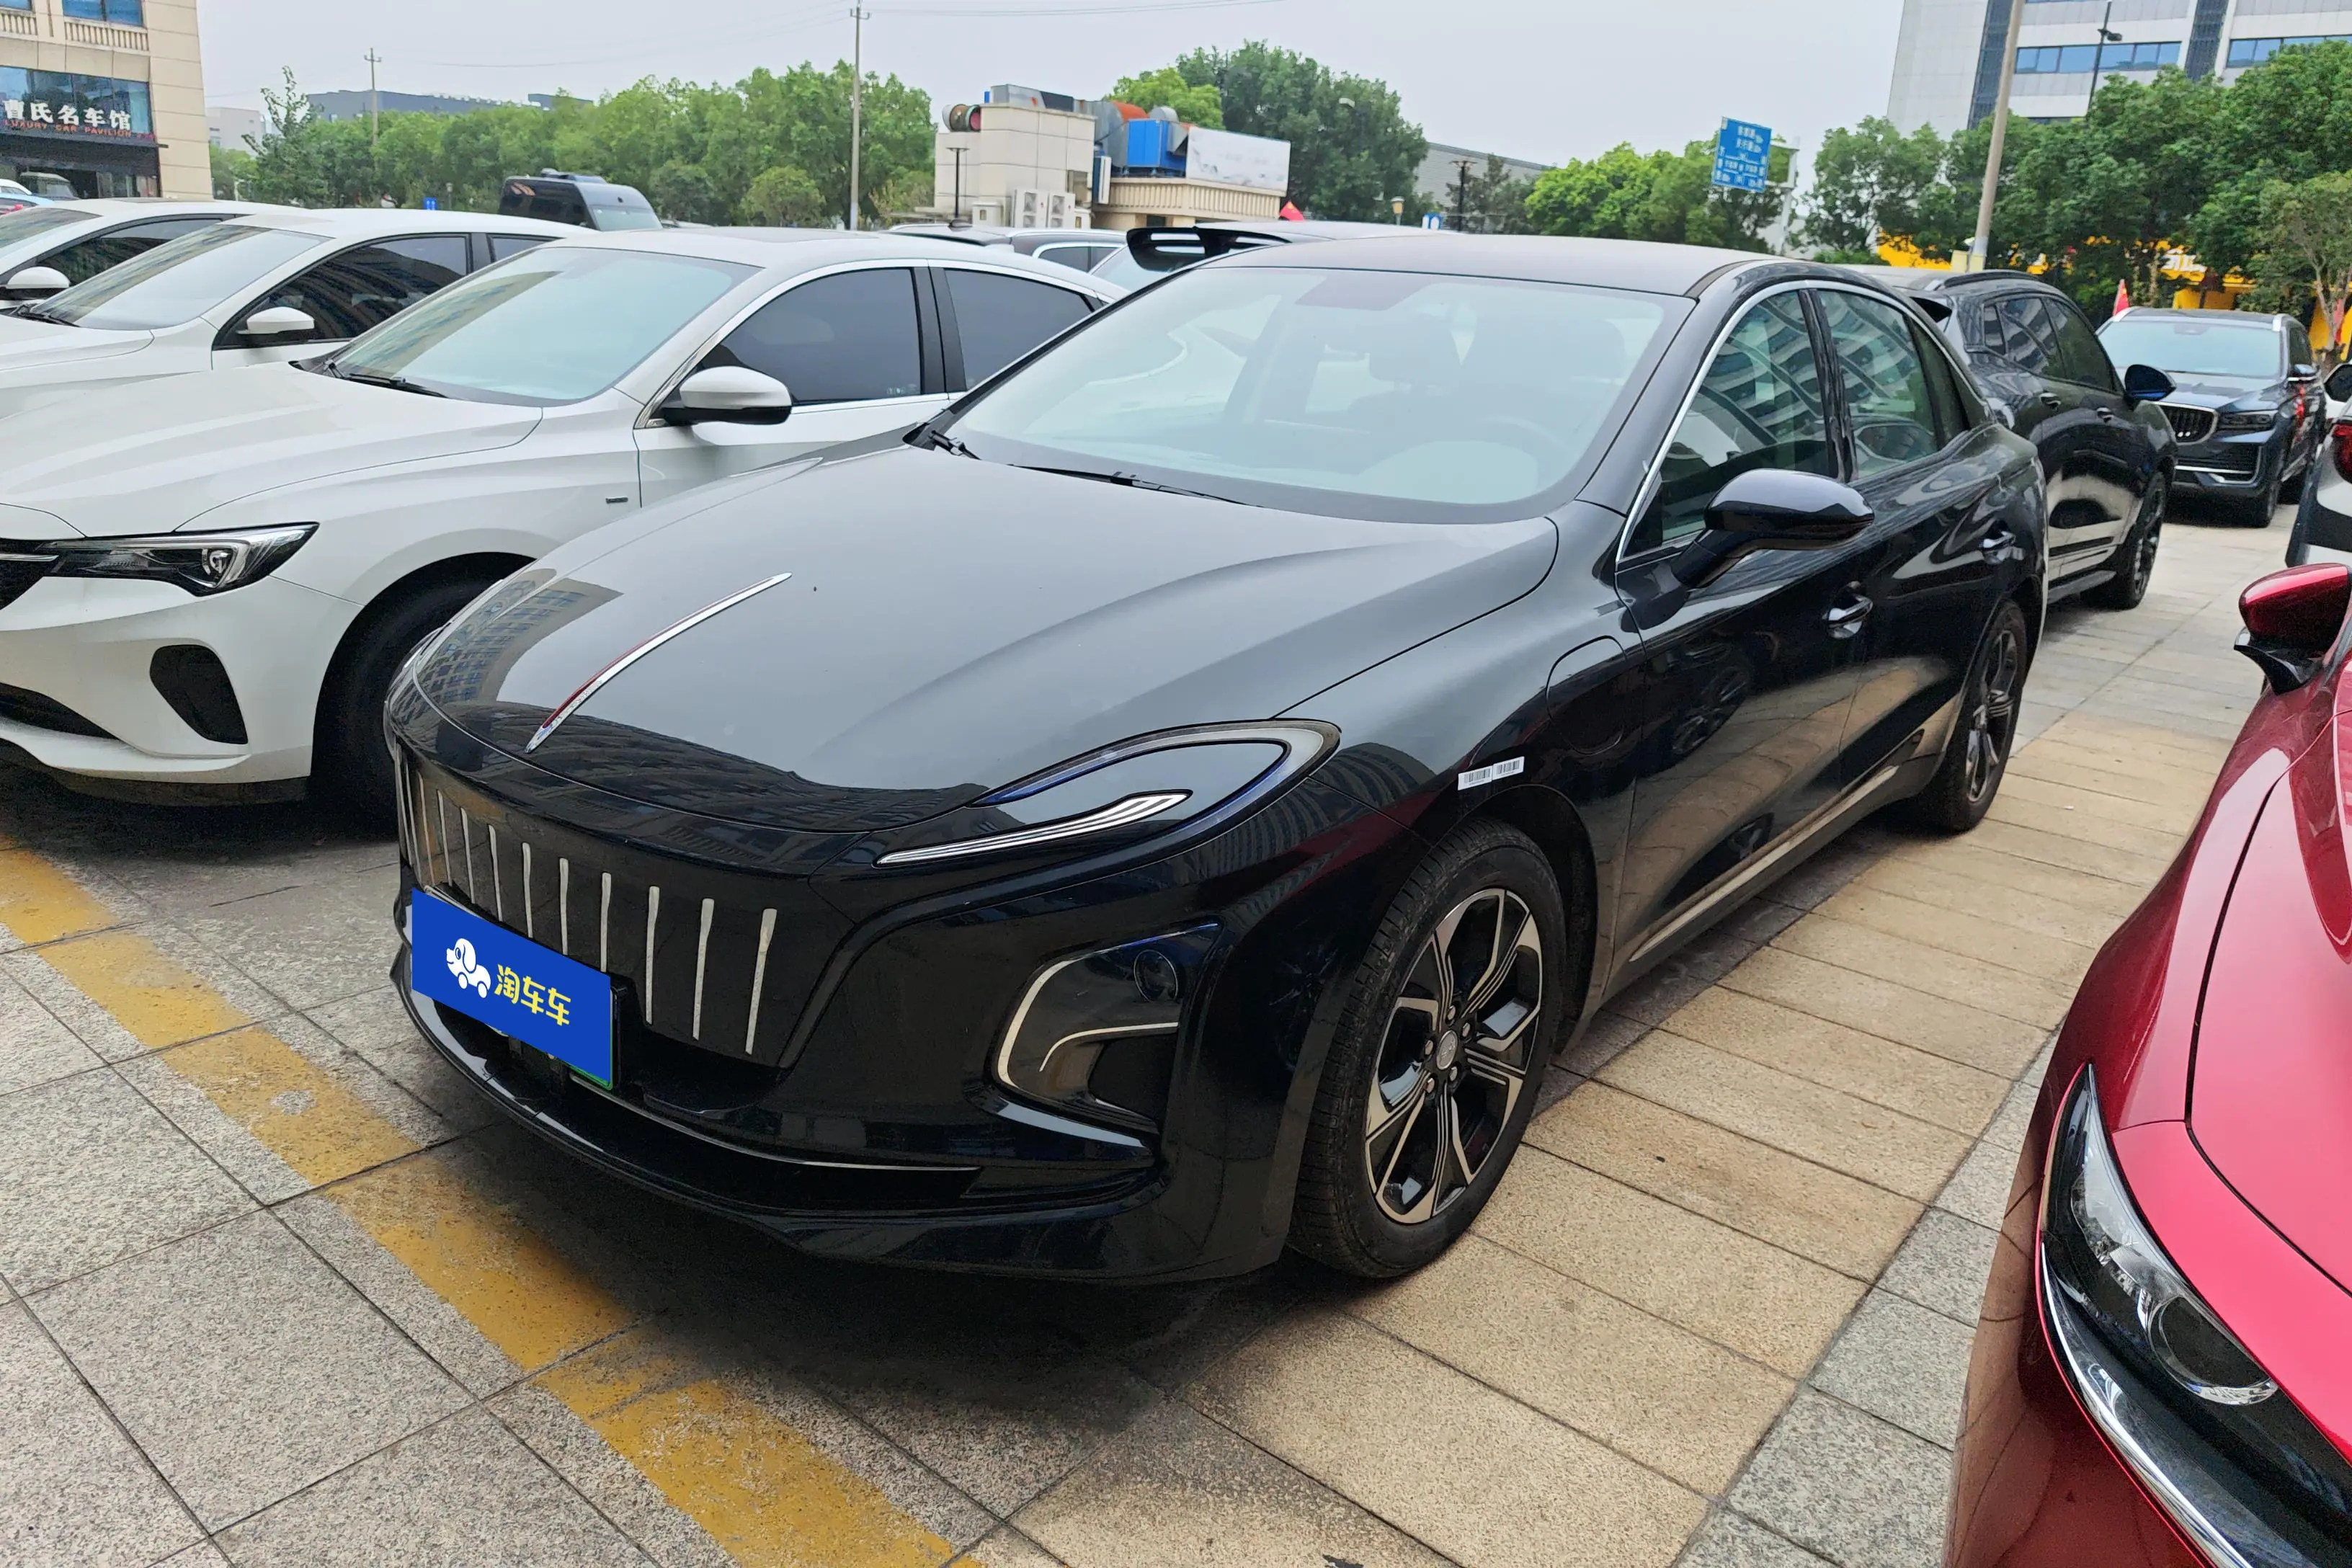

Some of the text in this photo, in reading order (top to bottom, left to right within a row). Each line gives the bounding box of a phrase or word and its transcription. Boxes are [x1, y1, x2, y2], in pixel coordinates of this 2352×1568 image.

[3, 99, 131, 130] 曹氏名车馆
[84, 126, 132, 138] PAVILION
